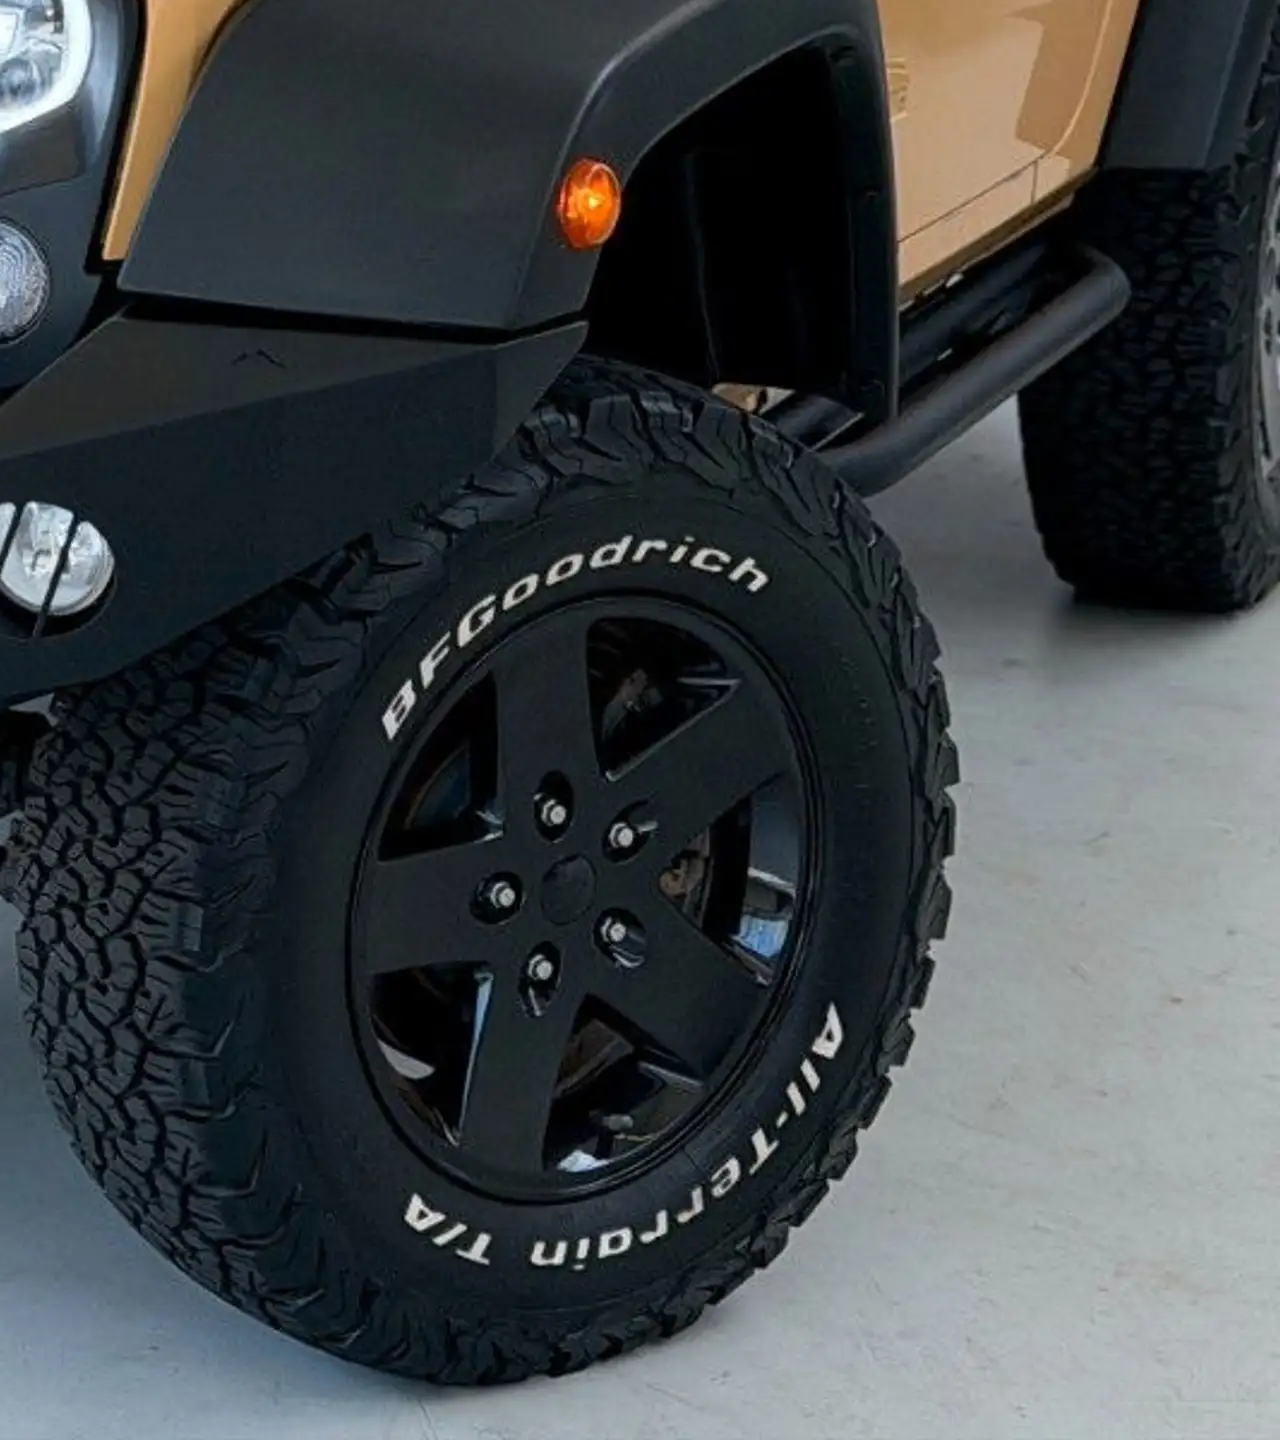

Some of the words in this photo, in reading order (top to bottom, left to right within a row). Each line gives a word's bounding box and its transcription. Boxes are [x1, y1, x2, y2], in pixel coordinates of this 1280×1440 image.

[381, 535, 770, 741] BFGoodrich
[403, 1192, 493, 1265] T/A
[529, 1001, 844, 1272] All-Terrain
